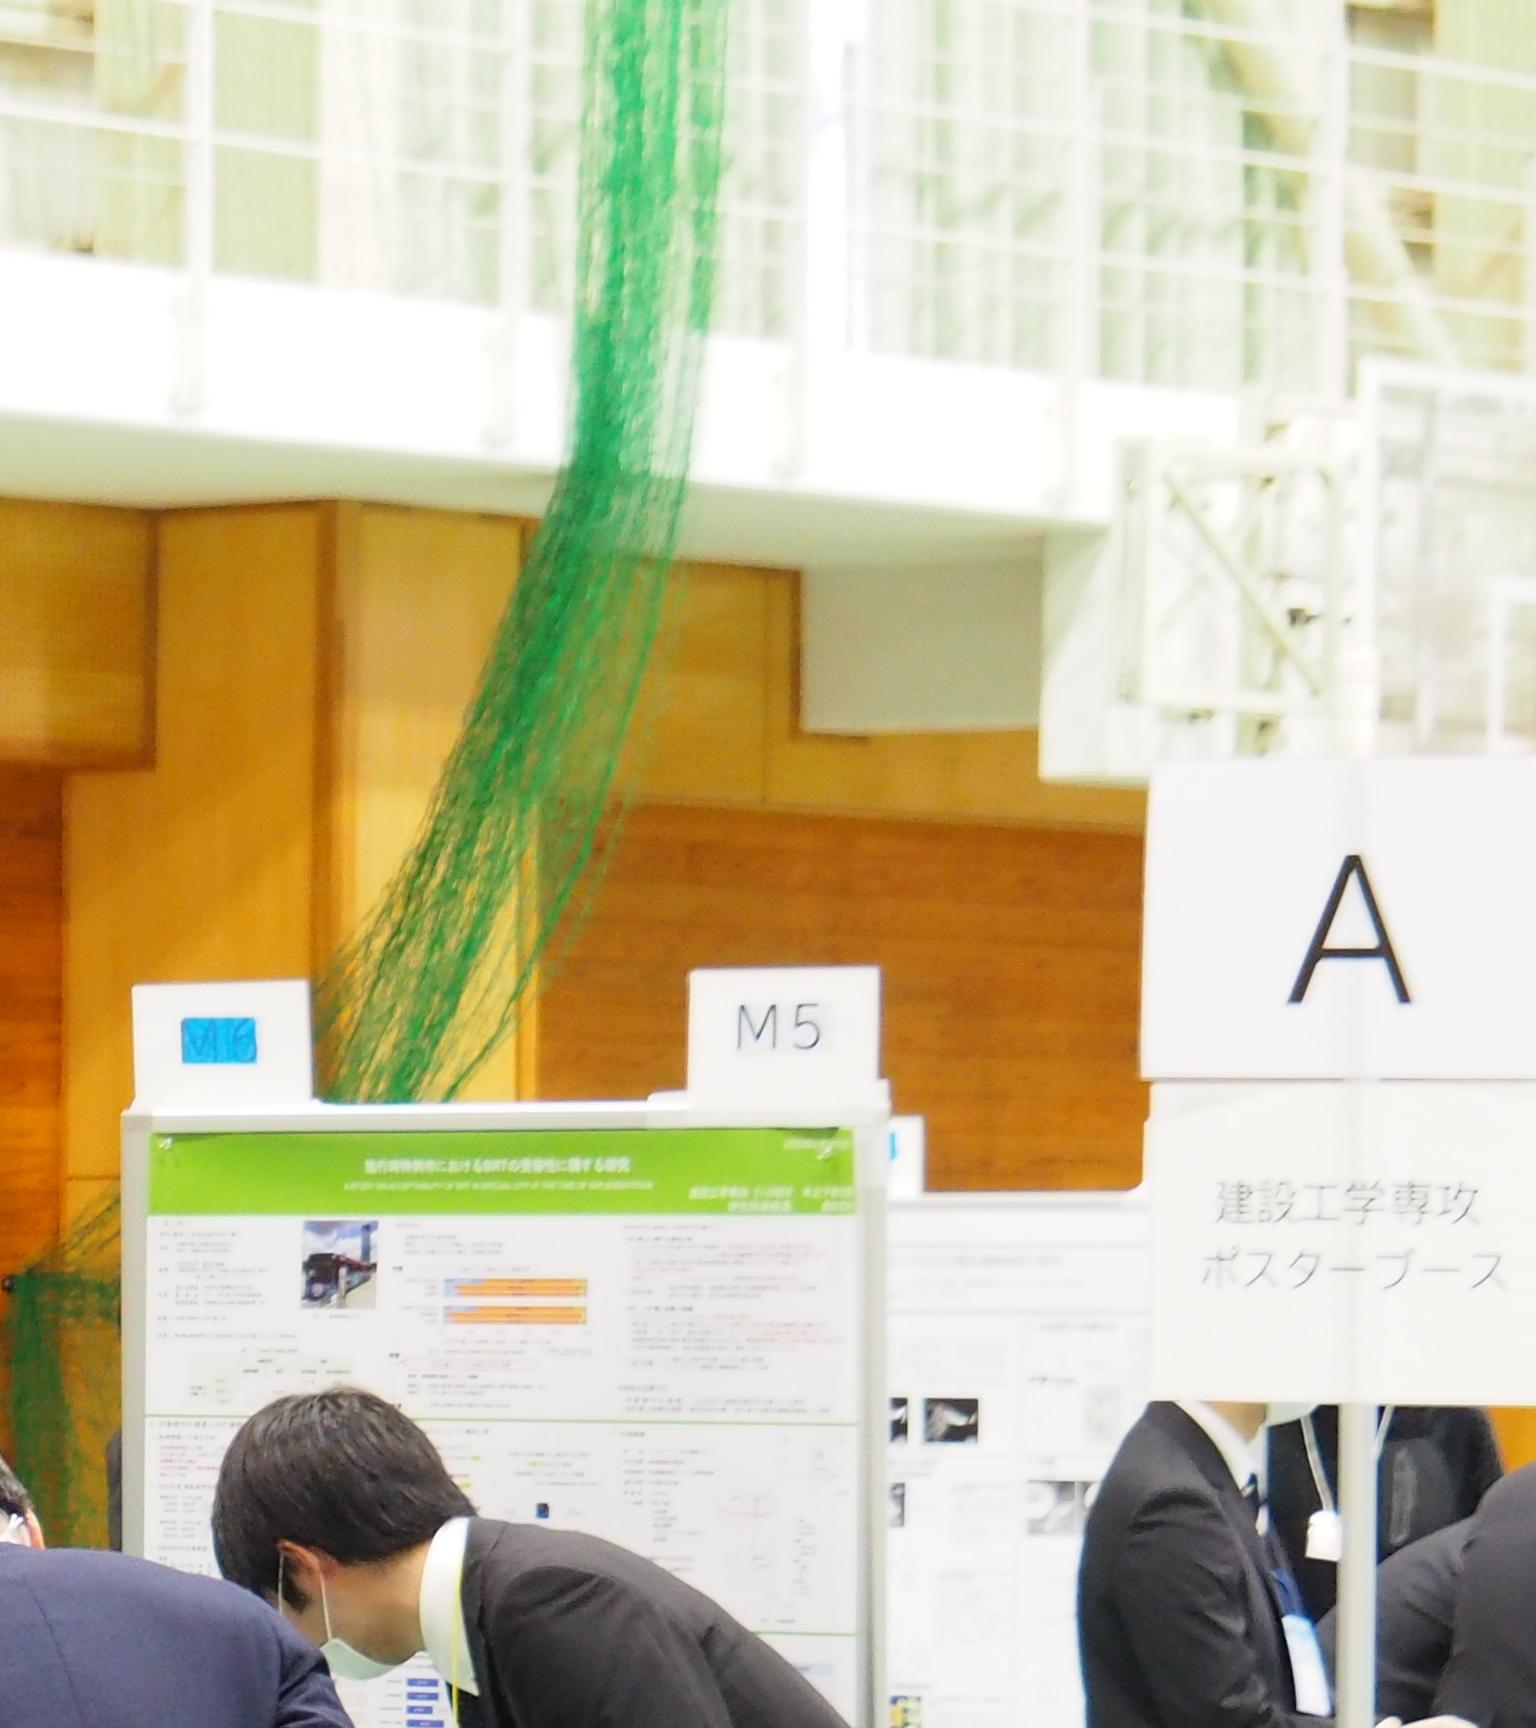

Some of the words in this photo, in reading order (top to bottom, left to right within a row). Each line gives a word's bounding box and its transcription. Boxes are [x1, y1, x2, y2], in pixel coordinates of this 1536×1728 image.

[1286, 853, 1413, 1004] A
[736, 1003, 821, 1050] M5
[1215, 1179, 1481, 1227] 建設工学専攻
[1200, 1247, 1506, 1292] ポスターブース
